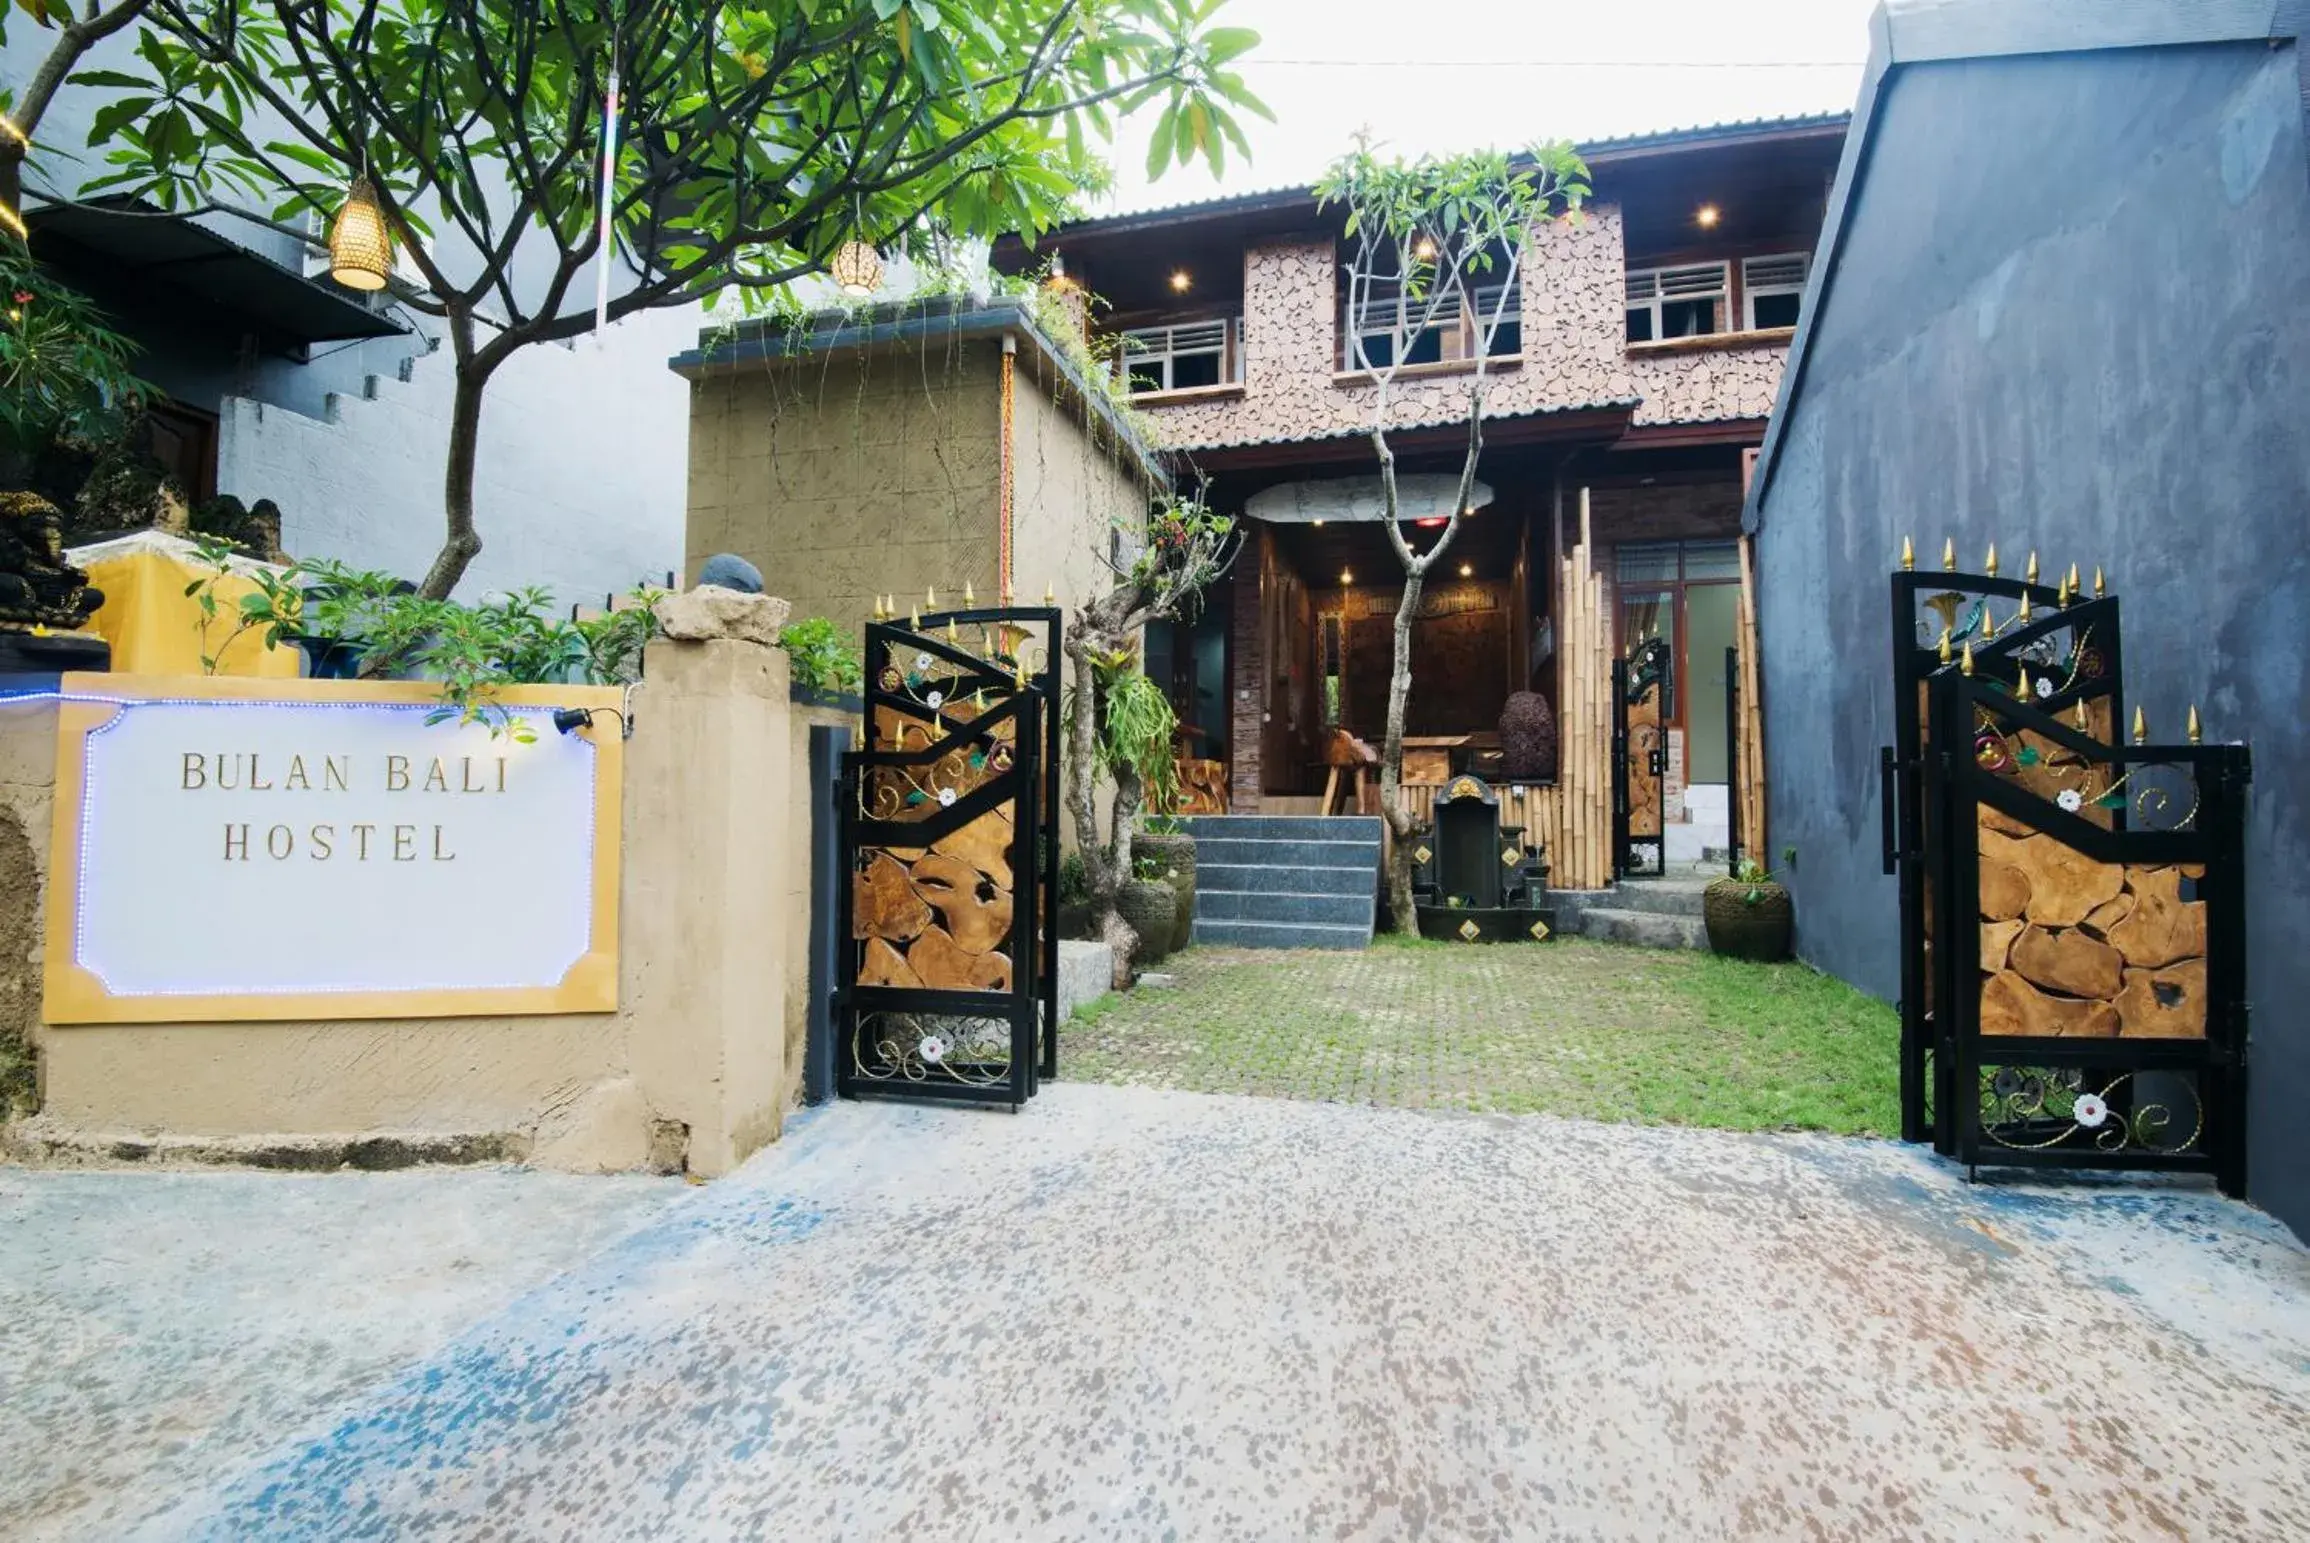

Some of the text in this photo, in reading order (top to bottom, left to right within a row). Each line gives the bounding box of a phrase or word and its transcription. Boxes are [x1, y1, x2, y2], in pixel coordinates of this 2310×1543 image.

[182, 752, 507, 793] BULAN BALI
[224, 823, 456, 861] HOSTEL
